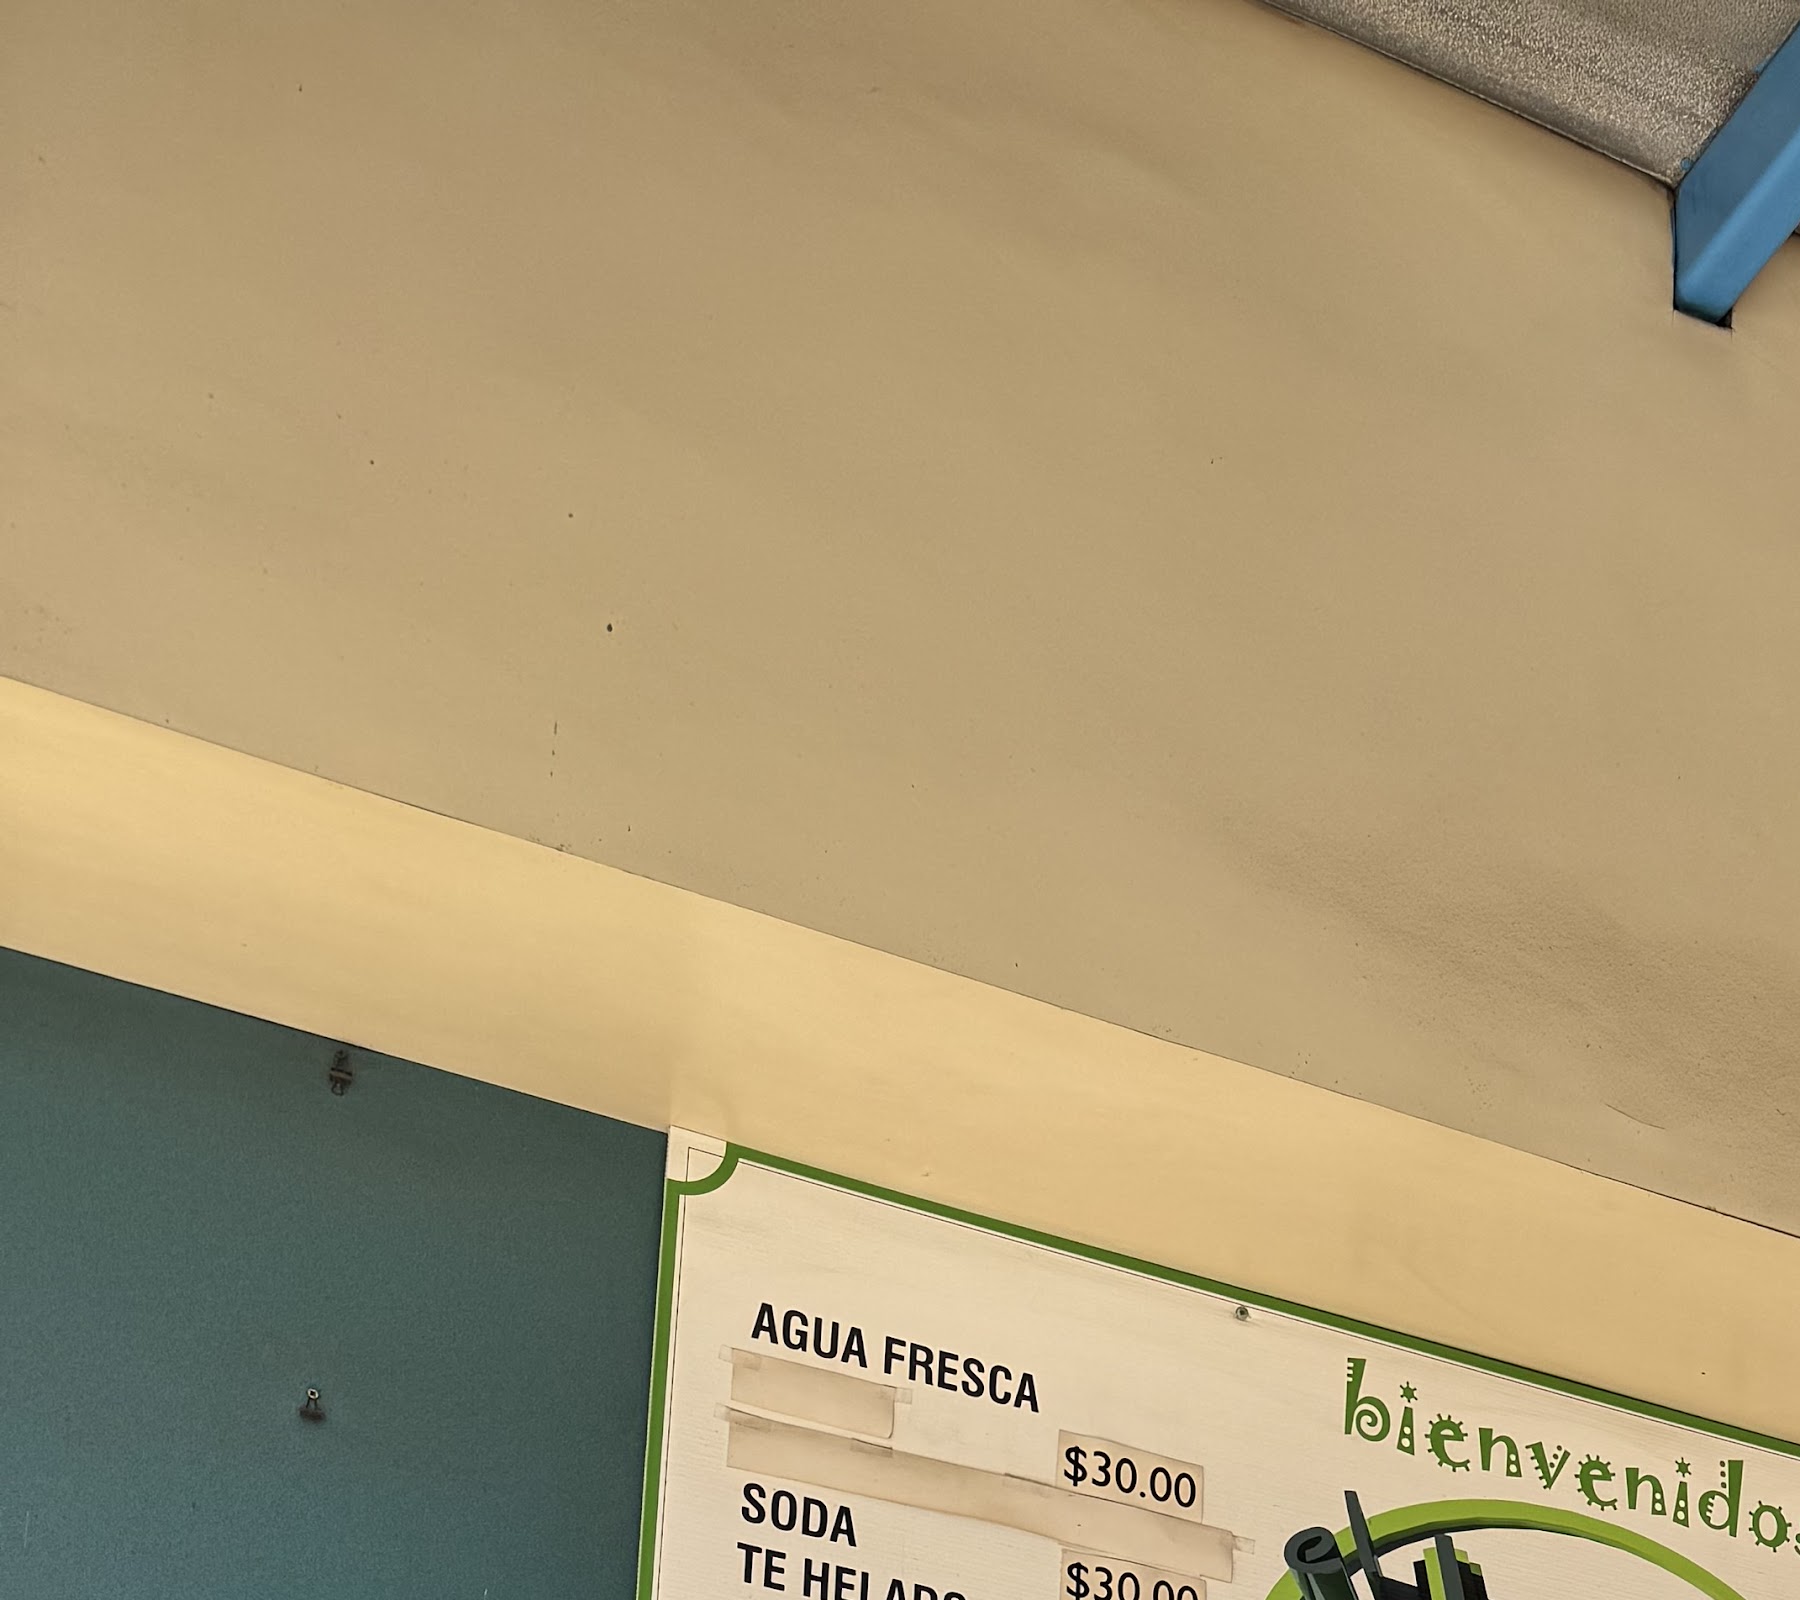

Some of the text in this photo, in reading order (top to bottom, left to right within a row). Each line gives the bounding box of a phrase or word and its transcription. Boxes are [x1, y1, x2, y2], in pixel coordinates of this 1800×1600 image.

[752, 1303, 1038, 1412] AGUA FRESCA
[1064, 1446, 1195, 1507] $30.00
[742, 1483, 856, 1547] SODA
[737, 1542, 786, 1591] TE
